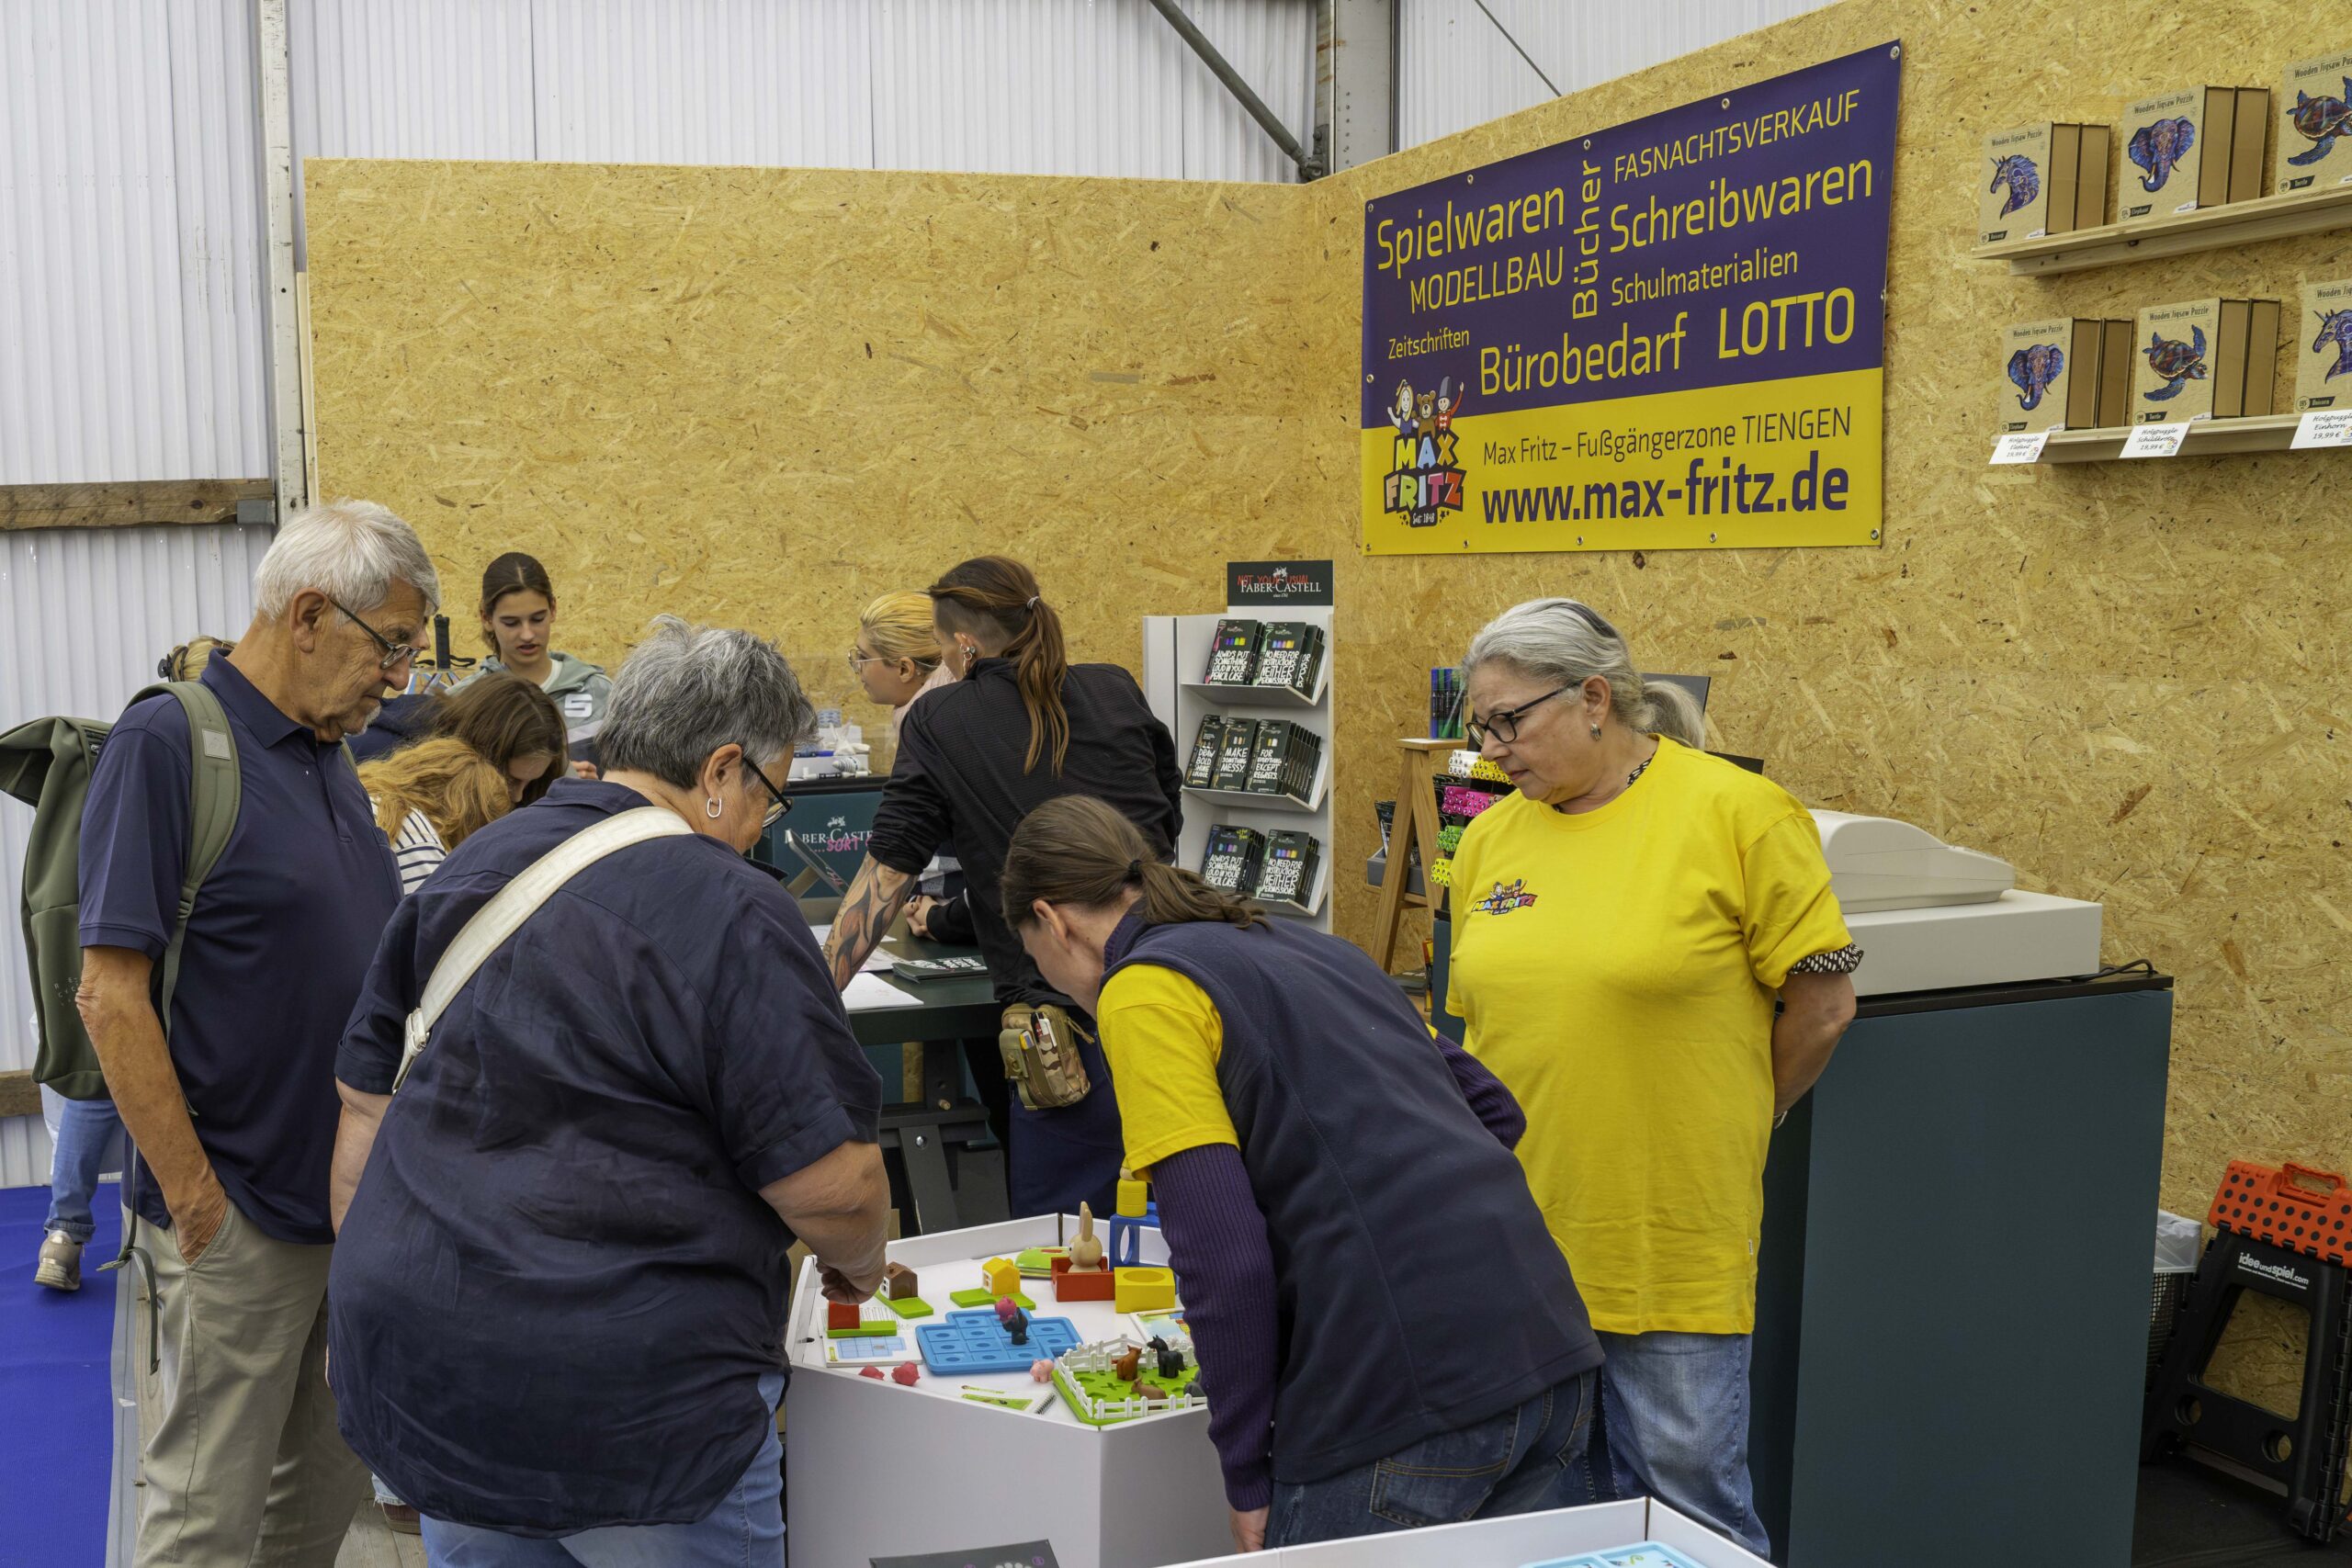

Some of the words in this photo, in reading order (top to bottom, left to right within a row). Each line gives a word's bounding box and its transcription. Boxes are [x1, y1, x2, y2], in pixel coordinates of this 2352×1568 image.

[2294, 65, 2319, 78] Wooden
[2320, 61, 2341, 74] Jigsaw
[2133, 103, 2155, 115] Wooden
[2157, 99, 2175, 110] Jigsaw
[2176, 93, 2194, 106] Puzzle
[1614, 89, 1861, 184] FASNACHTSVERKAUF
[1610, 158, 1872, 254] Schreibwaren
[1377, 186, 1565, 279] Spielwaren
[1573, 160, 1601, 320] Bücher
[1410, 246, 1564, 314] MODELLBAU
[1611, 249, 1799, 307] Schulmaterialien
[2316, 288, 2342, 299] Wooden
[2149, 310, 2170, 322] Wooden
[2171, 308, 2189, 320] Jigsaw
[2190, 306, 2209, 317] Puzzle
[2013, 328, 2031, 339] Wooden
[2032, 326, 2047, 337] Jigsaw
[2048, 323, 2064, 333] Puzzle
[1388, 326, 1470, 360] Zeitschriften
[1480, 312, 1687, 395] Bürobedarf
[1718, 287, 1855, 360] LOTTO
[1483, 441, 1517, 467] Max
[1521, 438, 1557, 463] Fritz
[1577, 421, 1736, 464] Fußgängerzone
[1742, 406, 1852, 446] TIENGEN
[2312, 432, 2334, 440] 19,99
[1395, 434, 1455, 472] MAX
[1385, 471, 1463, 512] FRITZ
[1482, 449, 1849, 524] www.max-fritz.de
[1237, 574, 1253, 586] NOT
[1257, 574, 1281, 585] YOUR
[1287, 574, 1310, 584] USUAL
[1240, 579, 1322, 592] FABER-CASTELL
[1237, 650, 1250, 660] PUT
[1273, 650, 1288, 659] NEED
[1287, 650, 1300, 660] FOR
[1228, 672, 1244, 682] CASE
[1261, 665, 1295, 679] NEITHER
[1198, 748, 1216, 758] DRAW
[1225, 747, 1249, 758] MAKE
[1260, 749, 1274, 758] FOR
[1256, 763, 1281, 773] EXCEPT
[1230, 855, 1244, 865] PUT
[1276, 858, 1291, 868] NEED
[1290, 860, 1303, 870] FOR
[1225, 870, 1240, 878] YOUR
[1263, 874, 1298, 888] NEITHER
[1222, 877, 1237, 887] CASE
[1472, 899, 1500, 911] MAX
[1499, 895, 1538, 909] FRITZ
